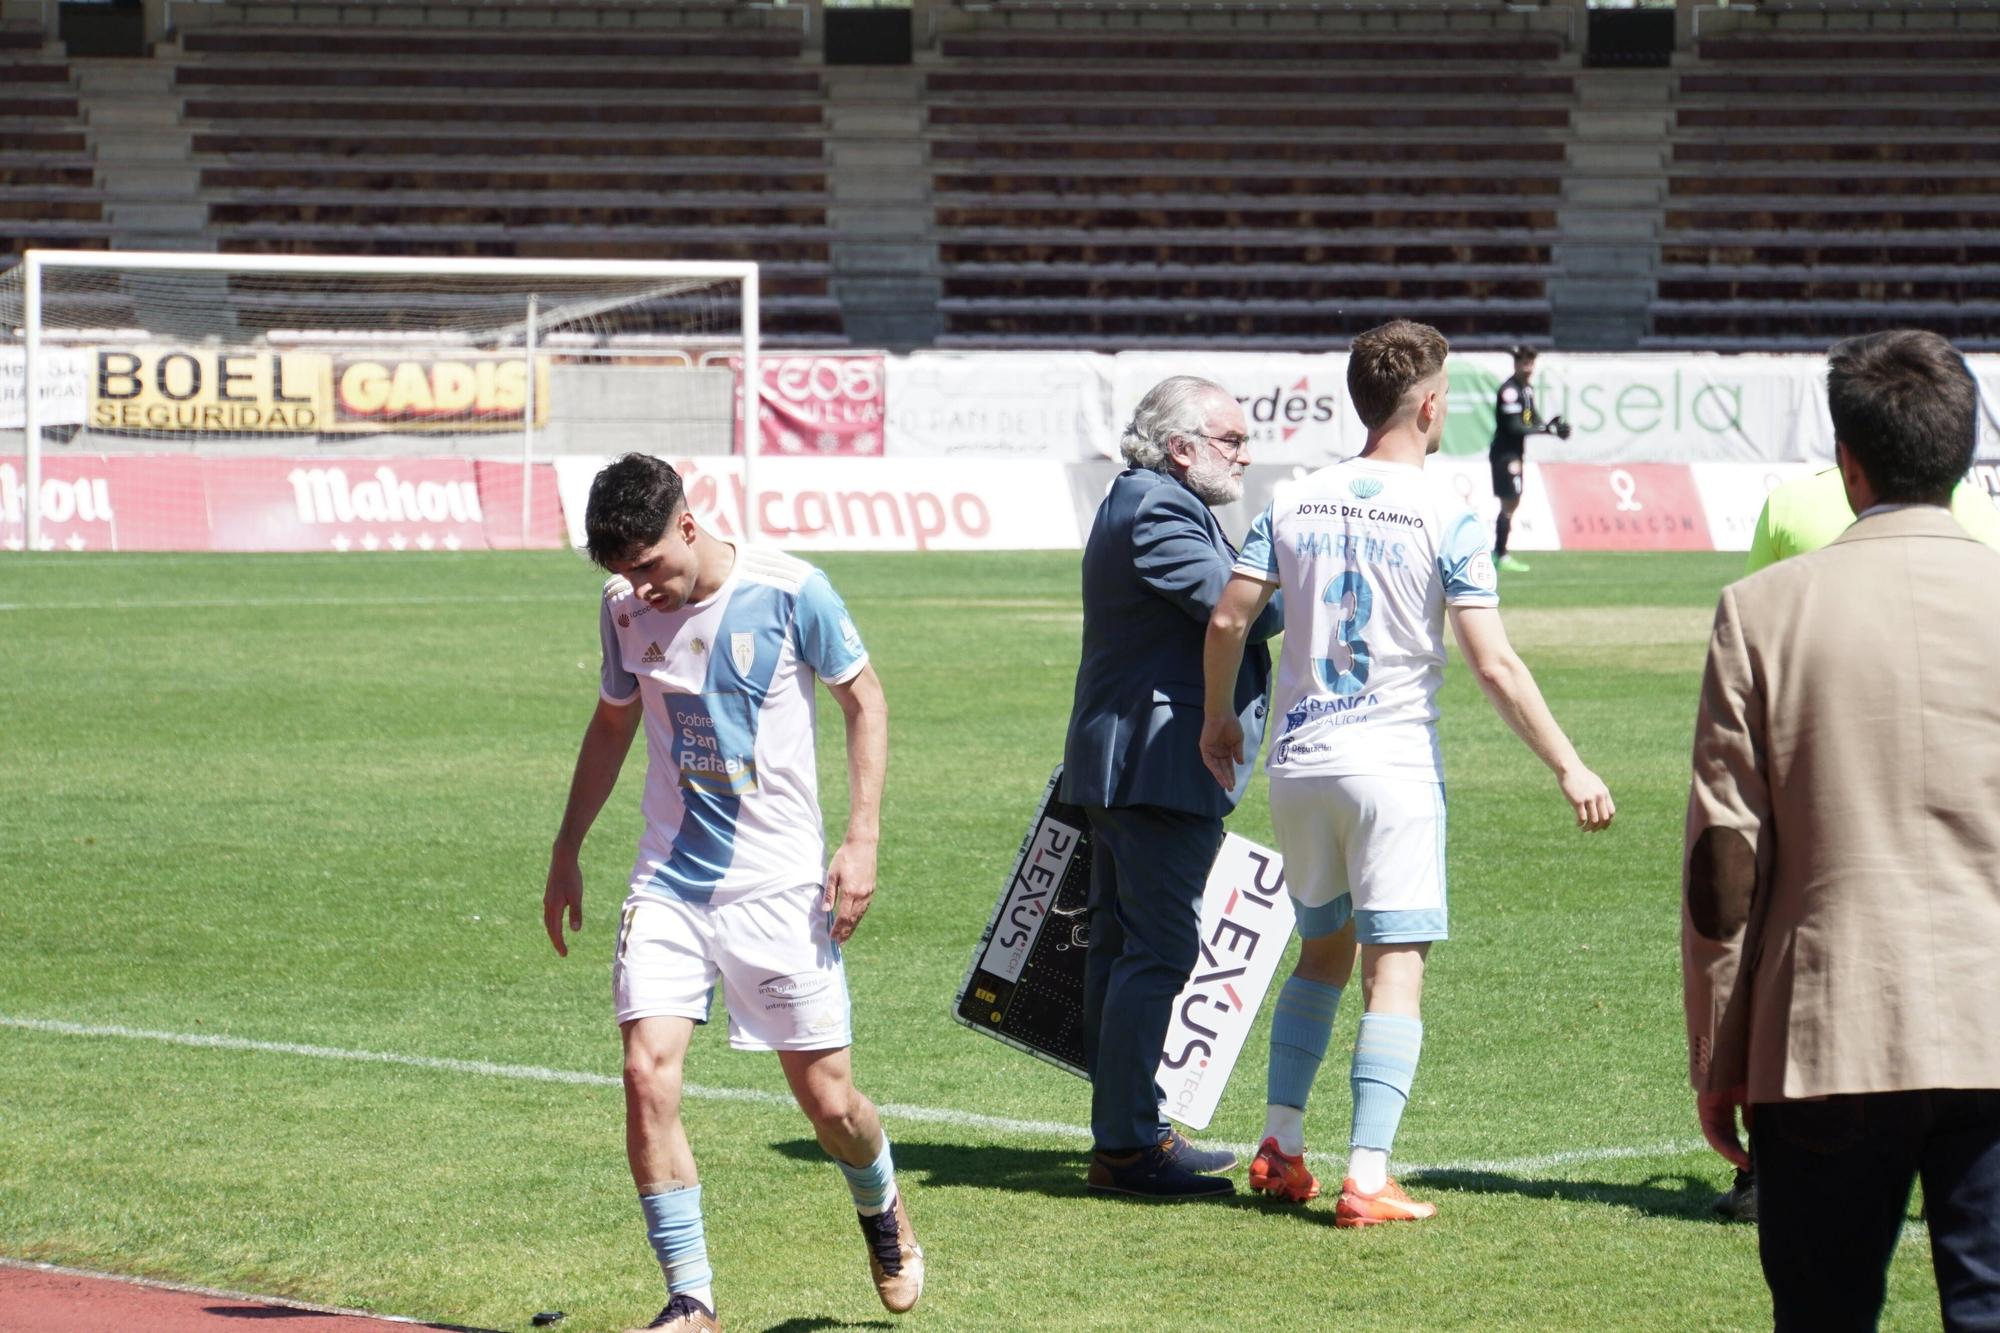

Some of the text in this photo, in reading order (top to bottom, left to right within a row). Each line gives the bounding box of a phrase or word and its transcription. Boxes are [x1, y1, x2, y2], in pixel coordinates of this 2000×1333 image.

[96, 351, 312, 402] BOEL
[339, 360, 528, 414] GADIS
[1534, 368, 1743, 434] tisela
[95, 402, 317, 428] SEGURIDAD
[0, 463, 114, 523] hou
[287, 466, 484, 523] Mahou
[1296, 502, 1424, 530] JOYAS DEL CAMINO
[1312, 570, 1373, 695] 3
[676, 711, 714, 728] Cobre
[682, 728, 718, 750] San
[680, 750, 745, 774] Rafael
[1000, 827, 1071, 948] PLEXUS
[1162, 850, 1286, 1070] PLEXUS
